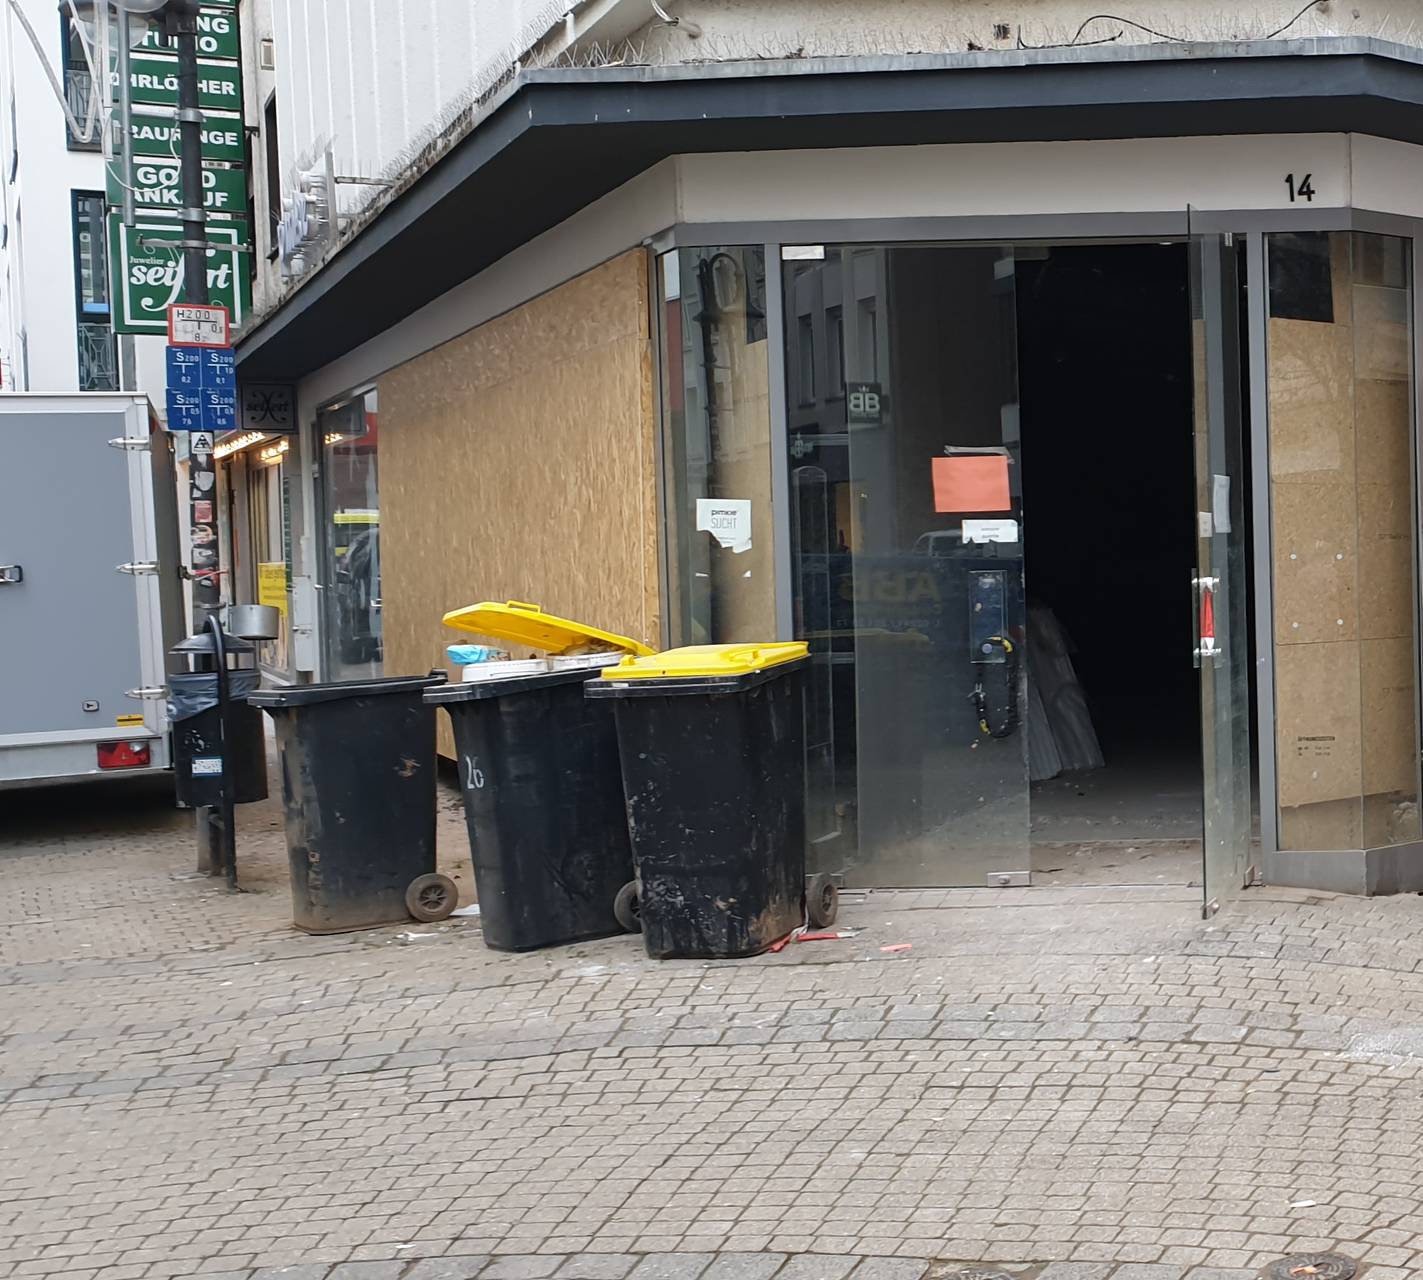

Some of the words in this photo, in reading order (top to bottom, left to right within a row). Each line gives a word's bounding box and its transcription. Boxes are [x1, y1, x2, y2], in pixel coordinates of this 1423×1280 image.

[137, 167, 216, 188] GOD
[134, 187, 228, 207] ANKUF
[1285, 174, 1316, 202] 14
[129, 256, 165, 265] Juwelier
